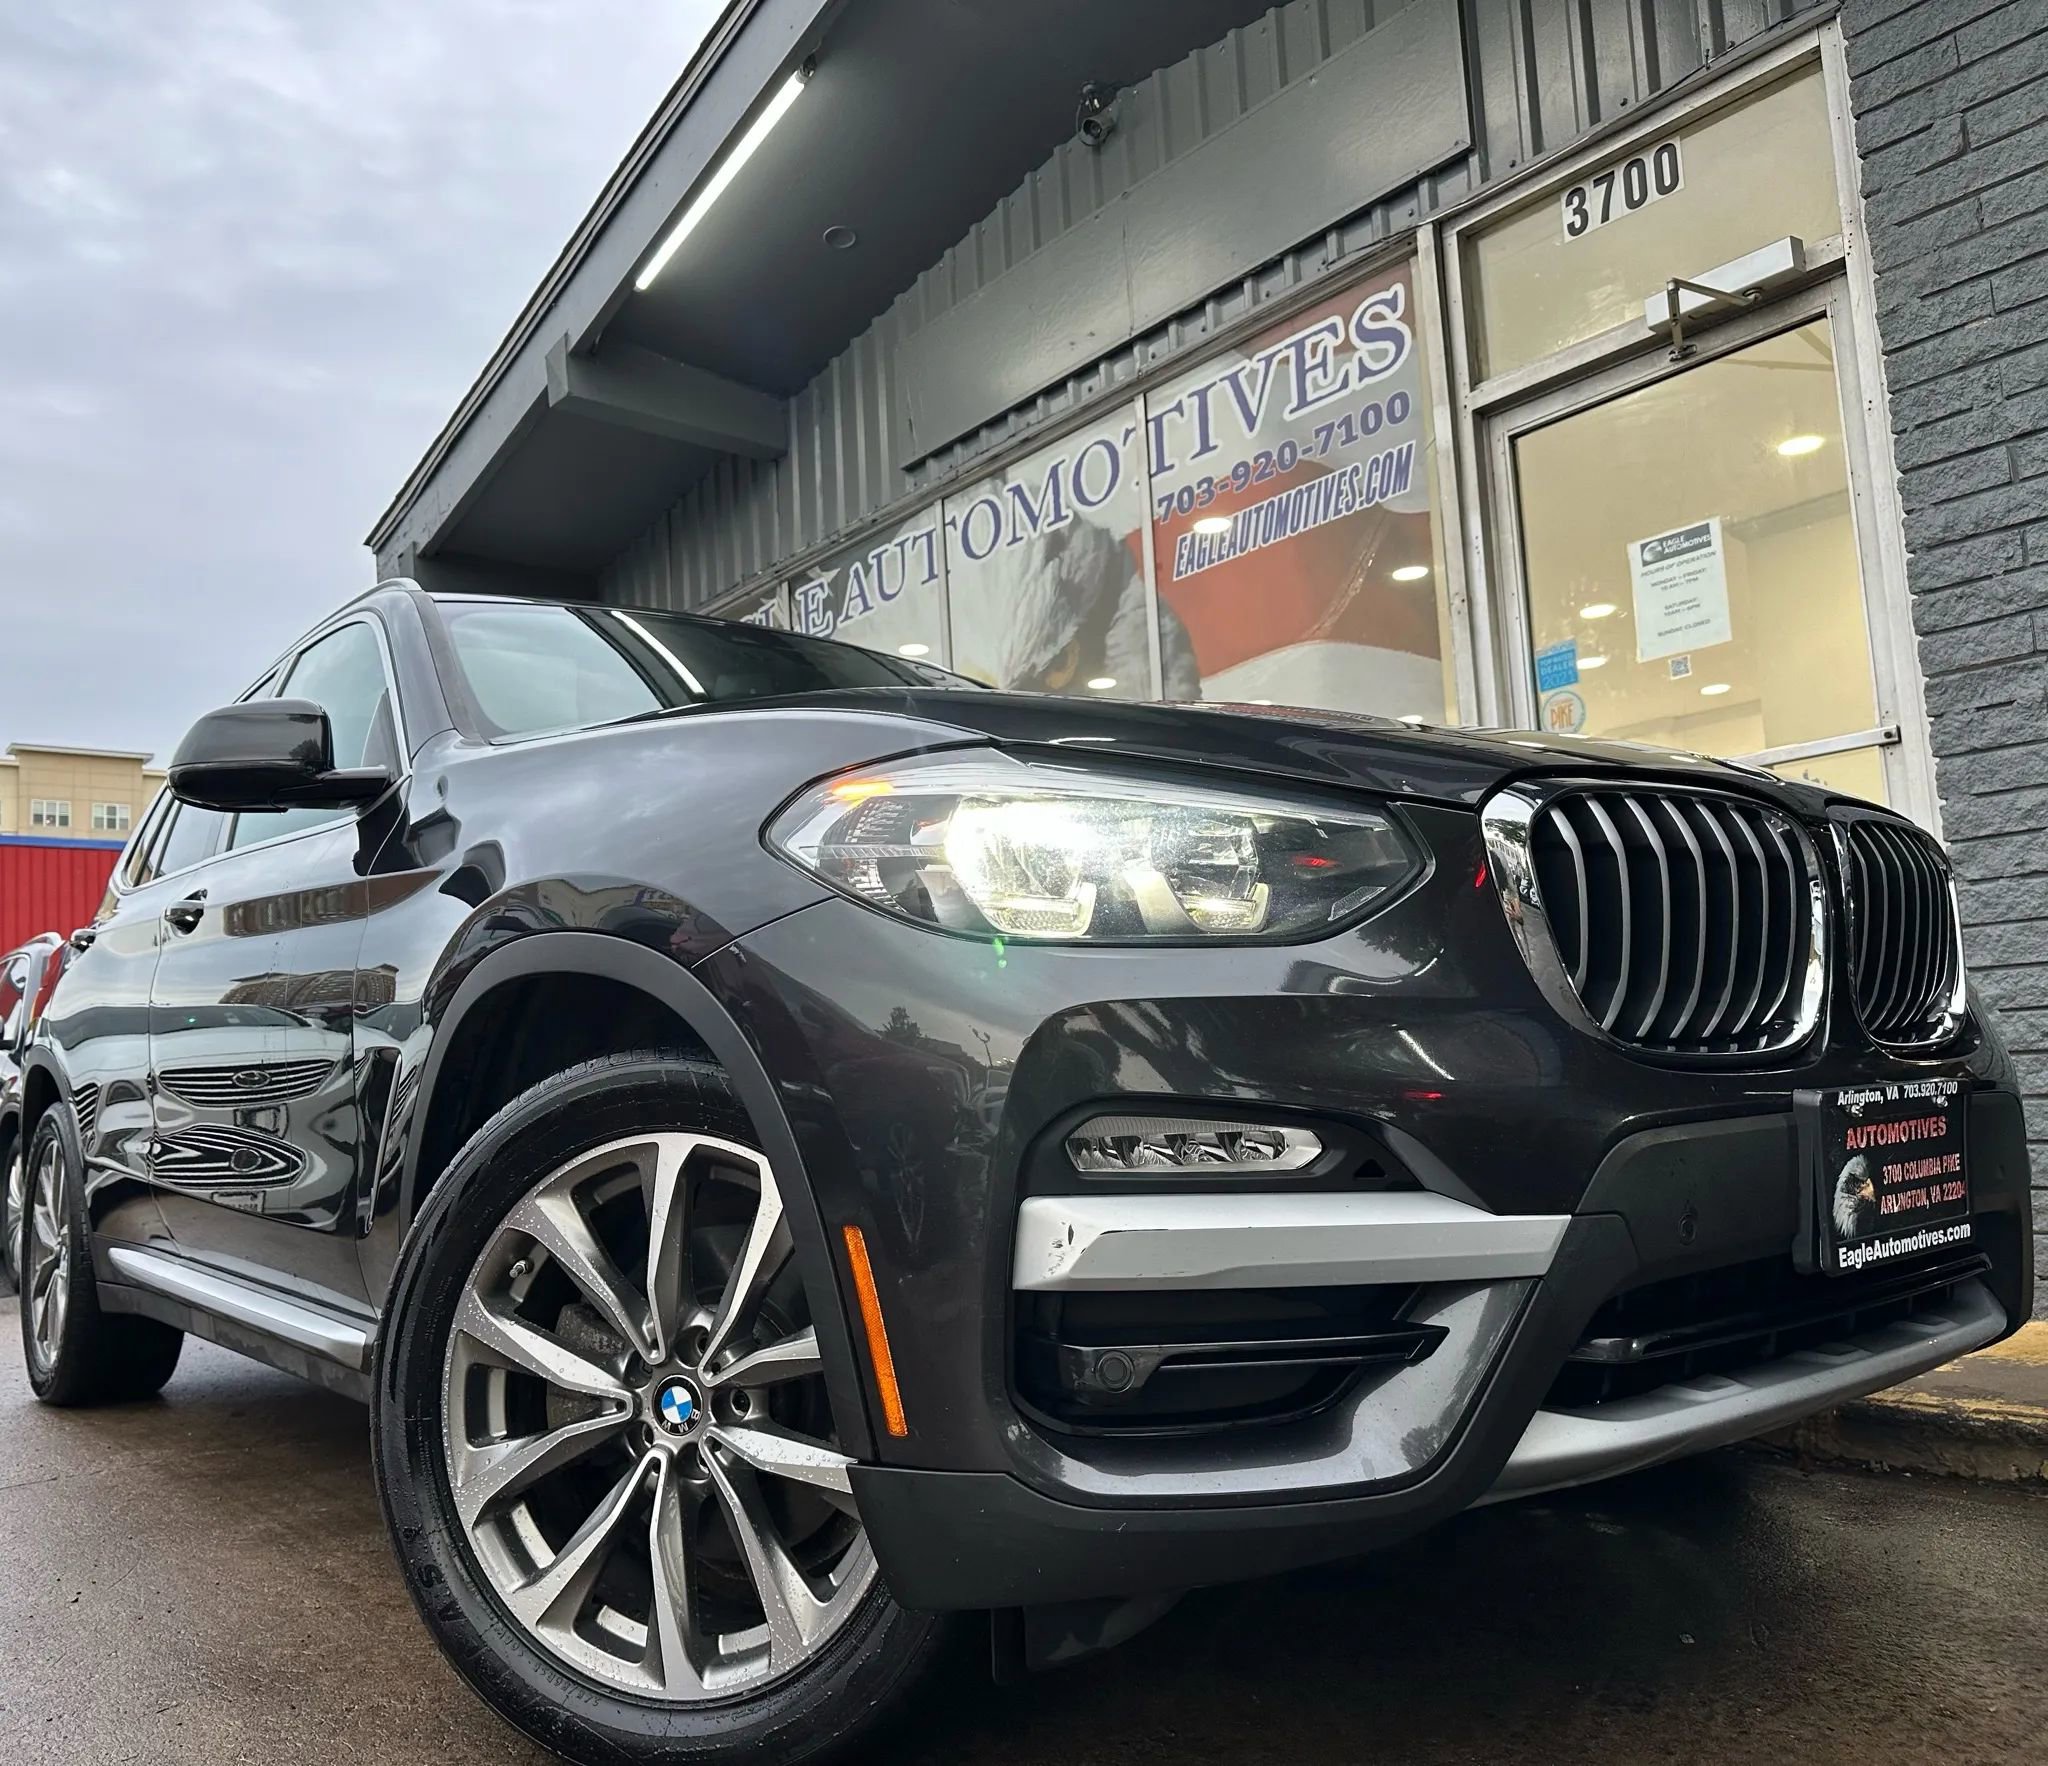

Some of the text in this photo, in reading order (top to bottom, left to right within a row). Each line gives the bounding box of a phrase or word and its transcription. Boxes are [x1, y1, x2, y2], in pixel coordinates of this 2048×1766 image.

[1565, 142, 1680, 237] 3700
[836, 282, 1412, 627] AUTOMOTIVES
[1158, 390, 1411, 524] 703-920-7100
[1172, 441, 1414, 581] EAGLEAUTOMOTIVES.COM
[1663, 534, 1685, 548] EAGLE
[1664, 533, 1712, 555] AUTOMOTIVES
[1837, 1081, 1958, 1106] Arlington, VA 703.920.7100
[1846, 1115, 1947, 1150] AUTOMOTIVES
[1882, 1153, 1961, 1185] 3700 COLUMBIA PIKE
[1880, 1187, 1930, 1215] ARLINGTON,
[1930, 1184, 1942, 1204] VA
[1838, 1222, 1971, 1269] EagleAutomotives.com
